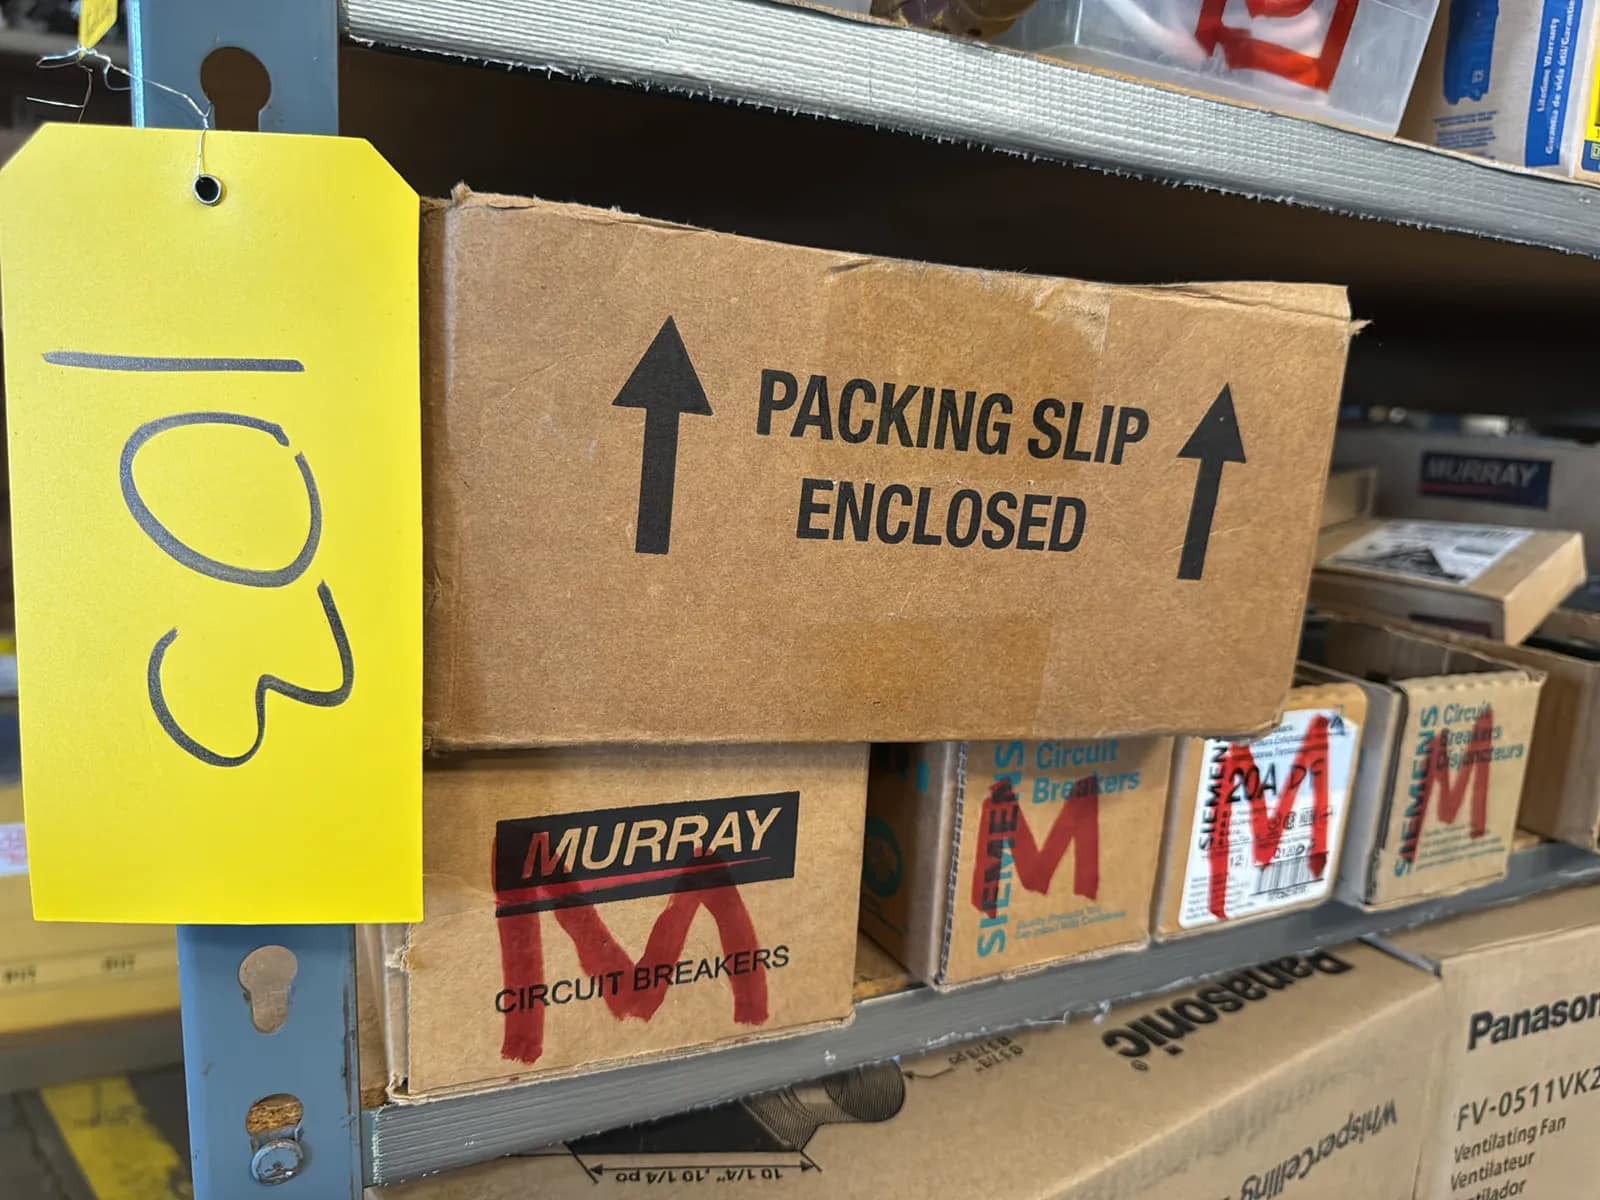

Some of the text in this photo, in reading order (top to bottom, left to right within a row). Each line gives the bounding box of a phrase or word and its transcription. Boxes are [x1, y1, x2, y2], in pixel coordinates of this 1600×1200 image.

[1536, 18, 1560, 112] Lifetime Warranty
[1556, 68, 1565, 90] vida
[1552, 94, 1561, 107] de
[756, 369, 1149, 466] PACKING SLIP
[1426, 457, 1540, 488] MURRAY
[796, 478, 1086, 552] ENCLOSED
[42, 351, 354, 767] 103
[1440, 725, 1503, 748] Breakers
[1444, 702, 1492, 725] Circuit
[1037, 740, 1120, 770] Circuit
[1226, 762, 1278, 804] 20A
[1032, 770, 1141, 804] Breakers
[1199, 738, 1229, 850] SIEMEN
[1395, 705, 1438, 877] SIEMENS
[522, 806, 783, 880] MURRAY
[1208, 714, 1330, 921] M
[971, 775, 1099, 920] M
[976, 740, 1025, 958] SIEMENS
[492, 836, 770, 1066] M
[495, 945, 790, 1014] CIRCUIT BREAKERS
[1102, 952, 1354, 1057] Panasonic
[1454, 1116, 1567, 1164] Ventilating Fan
[615, 1169, 641, 1183] po
[645, 1169, 677, 1184] 1/4
[761, 1167, 784, 1180] 10
[1450, 1151, 1535, 1192] Ventilateur
